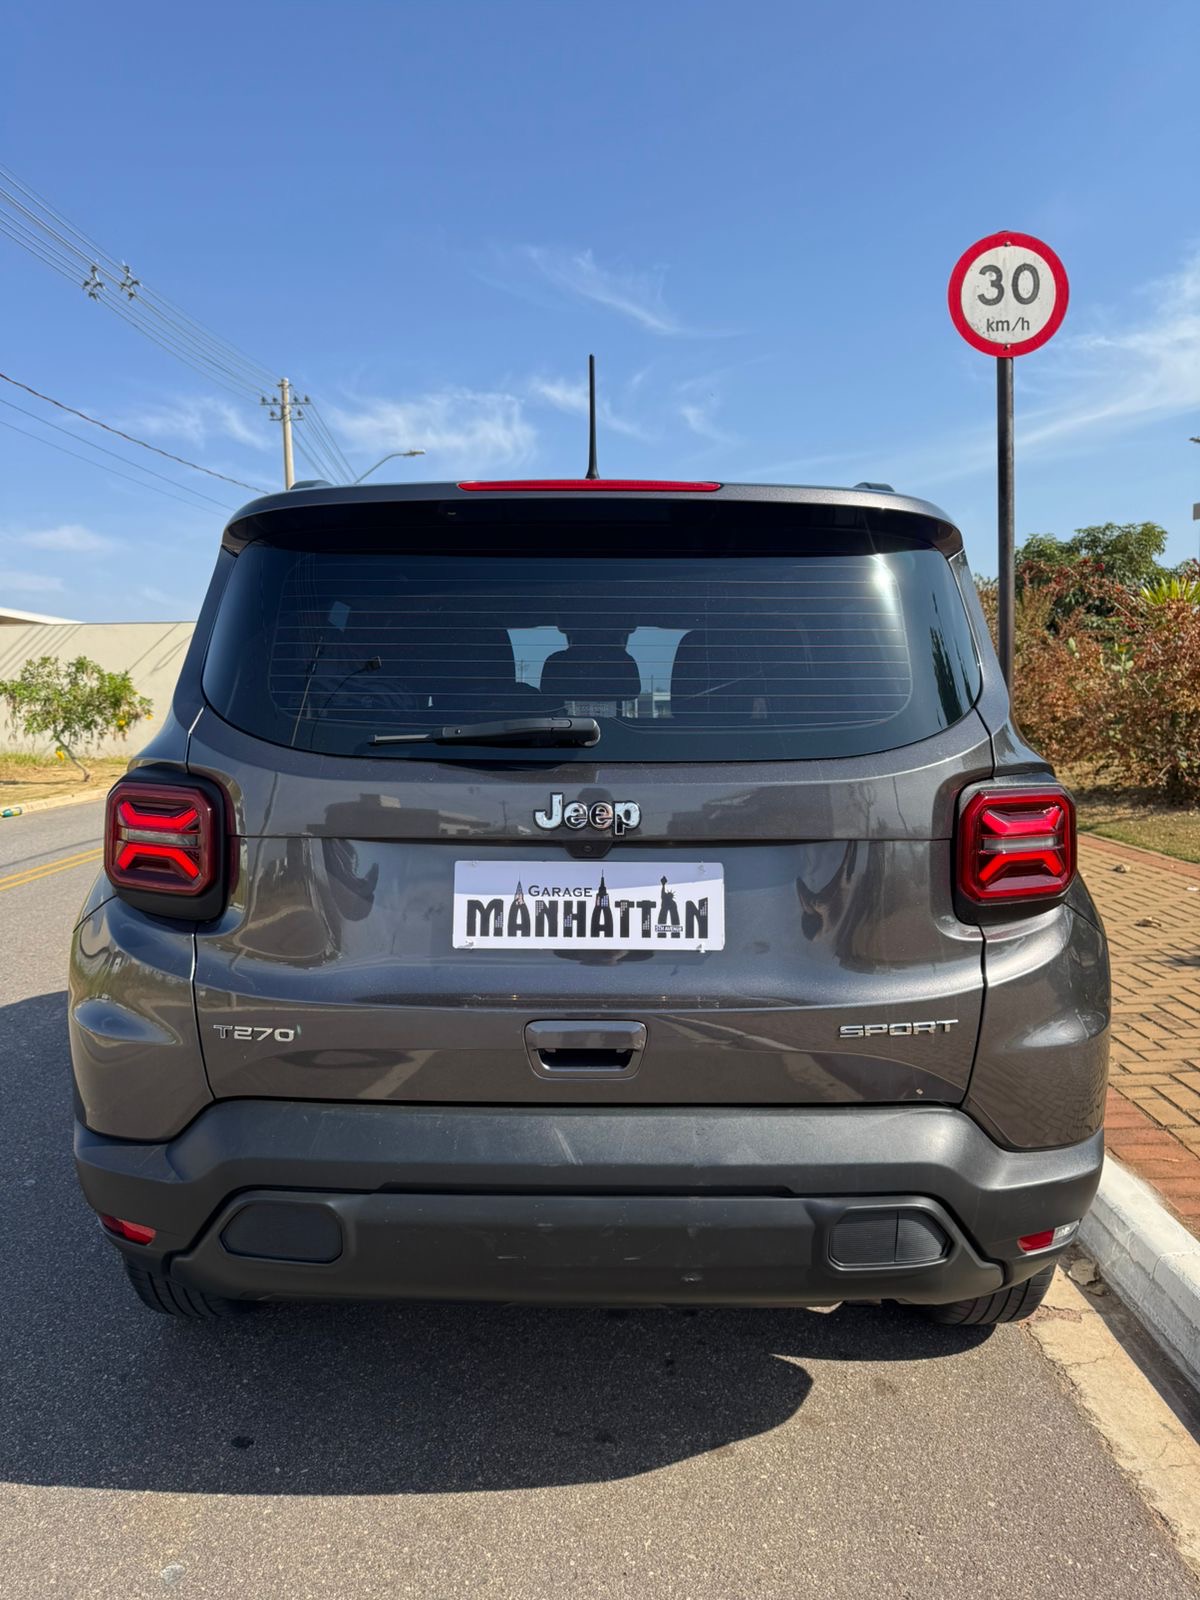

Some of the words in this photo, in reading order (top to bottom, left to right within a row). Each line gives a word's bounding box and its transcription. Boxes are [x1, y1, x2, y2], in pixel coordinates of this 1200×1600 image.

[977, 263, 1040, 306] 30
[986, 317, 1030, 332] km/h
[534, 792, 641, 836] Jeep
[528, 885, 593, 898] GARAGE
[466, 896, 709, 939] MANHATTAN
[213, 1024, 295, 1042] T270
[839, 1019, 959, 1038] SPORT
